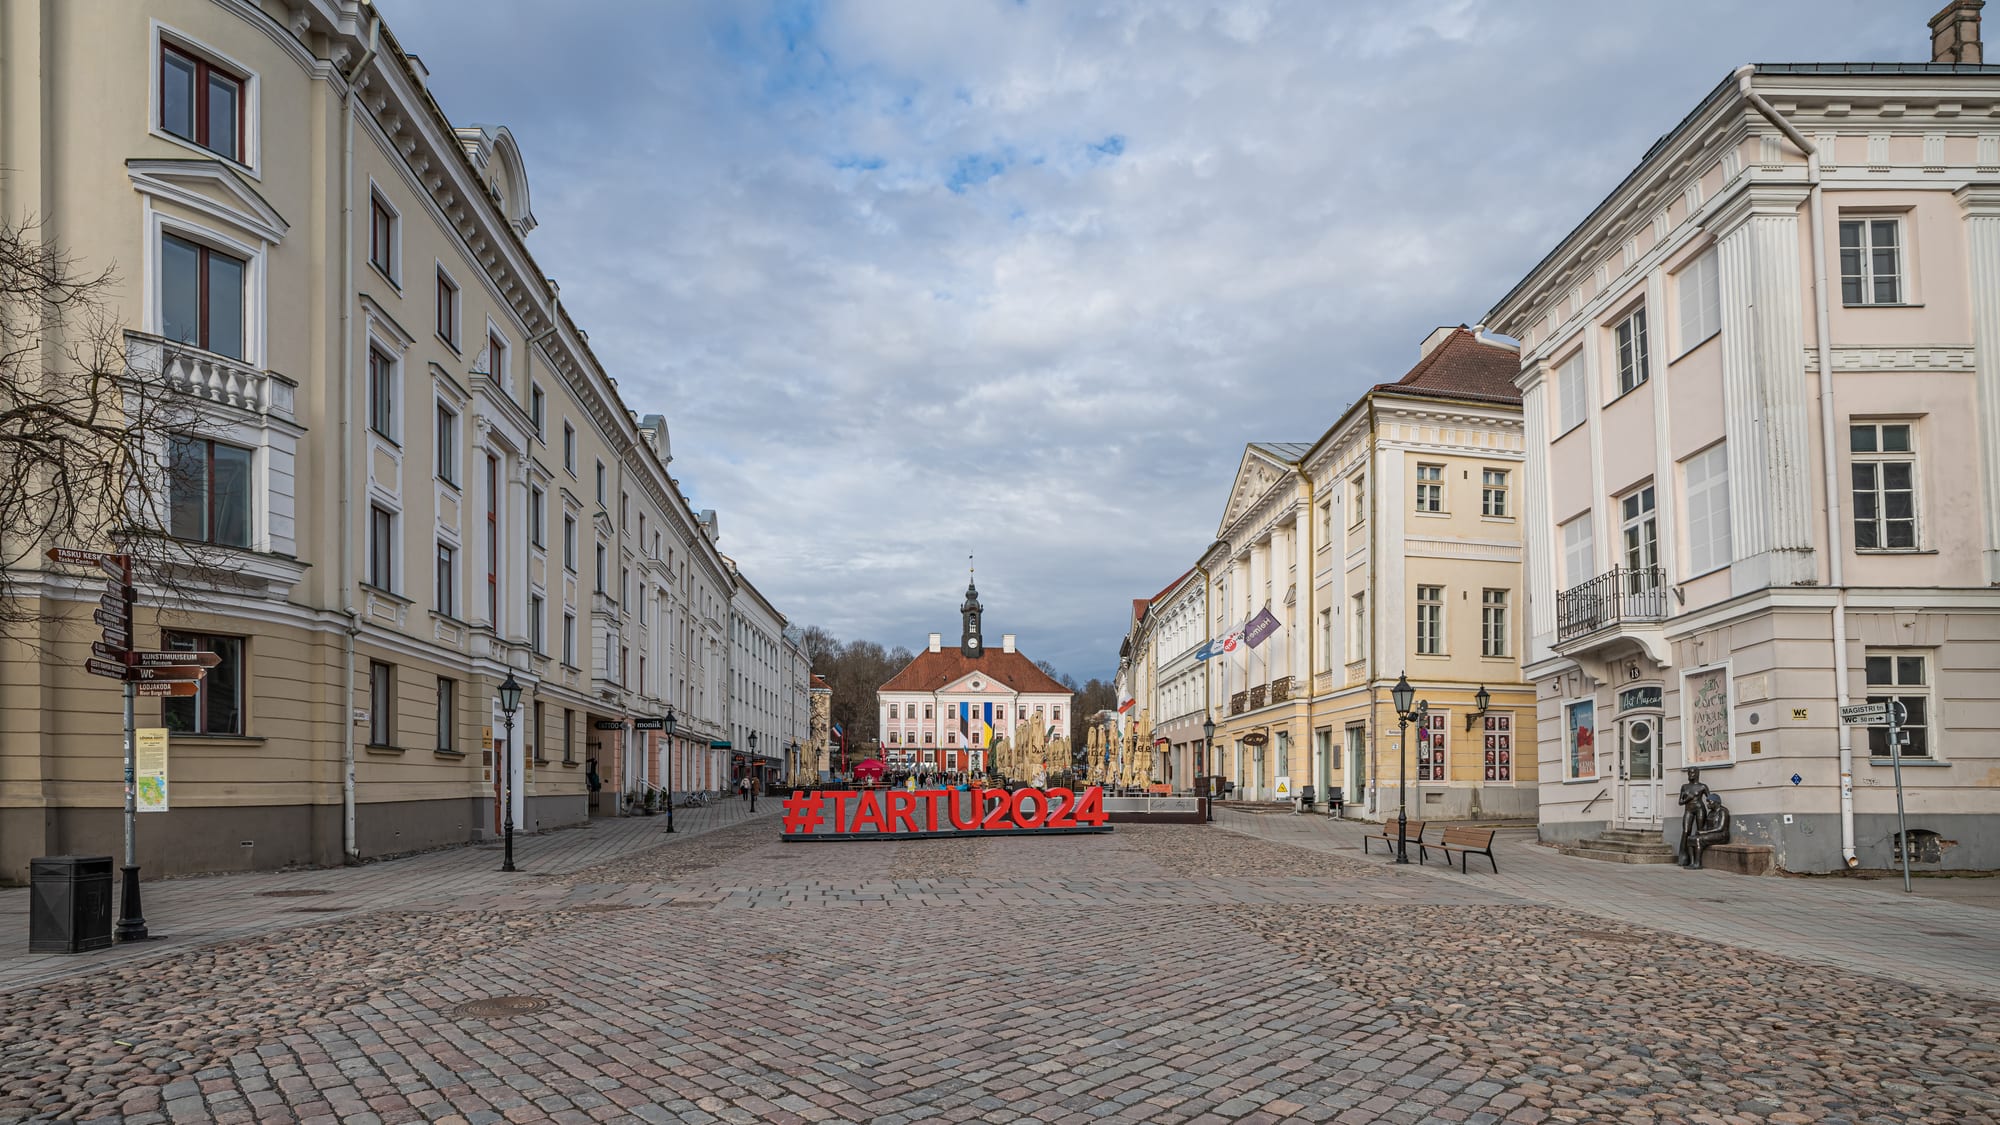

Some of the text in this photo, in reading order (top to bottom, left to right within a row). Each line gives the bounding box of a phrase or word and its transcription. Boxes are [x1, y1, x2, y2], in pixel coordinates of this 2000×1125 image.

[58, 550, 81, 558] TASKU
[142, 653, 198, 661] KUNSTIMUUSEUM
[140, 669, 154, 679] WC
[1631, 668, 1639, 678] 18
[1624, 692, 1635, 709] Art
[1842, 706, 1876, 715] MAGISTRI
[782, 786, 1109, 833] #TARTU2024
